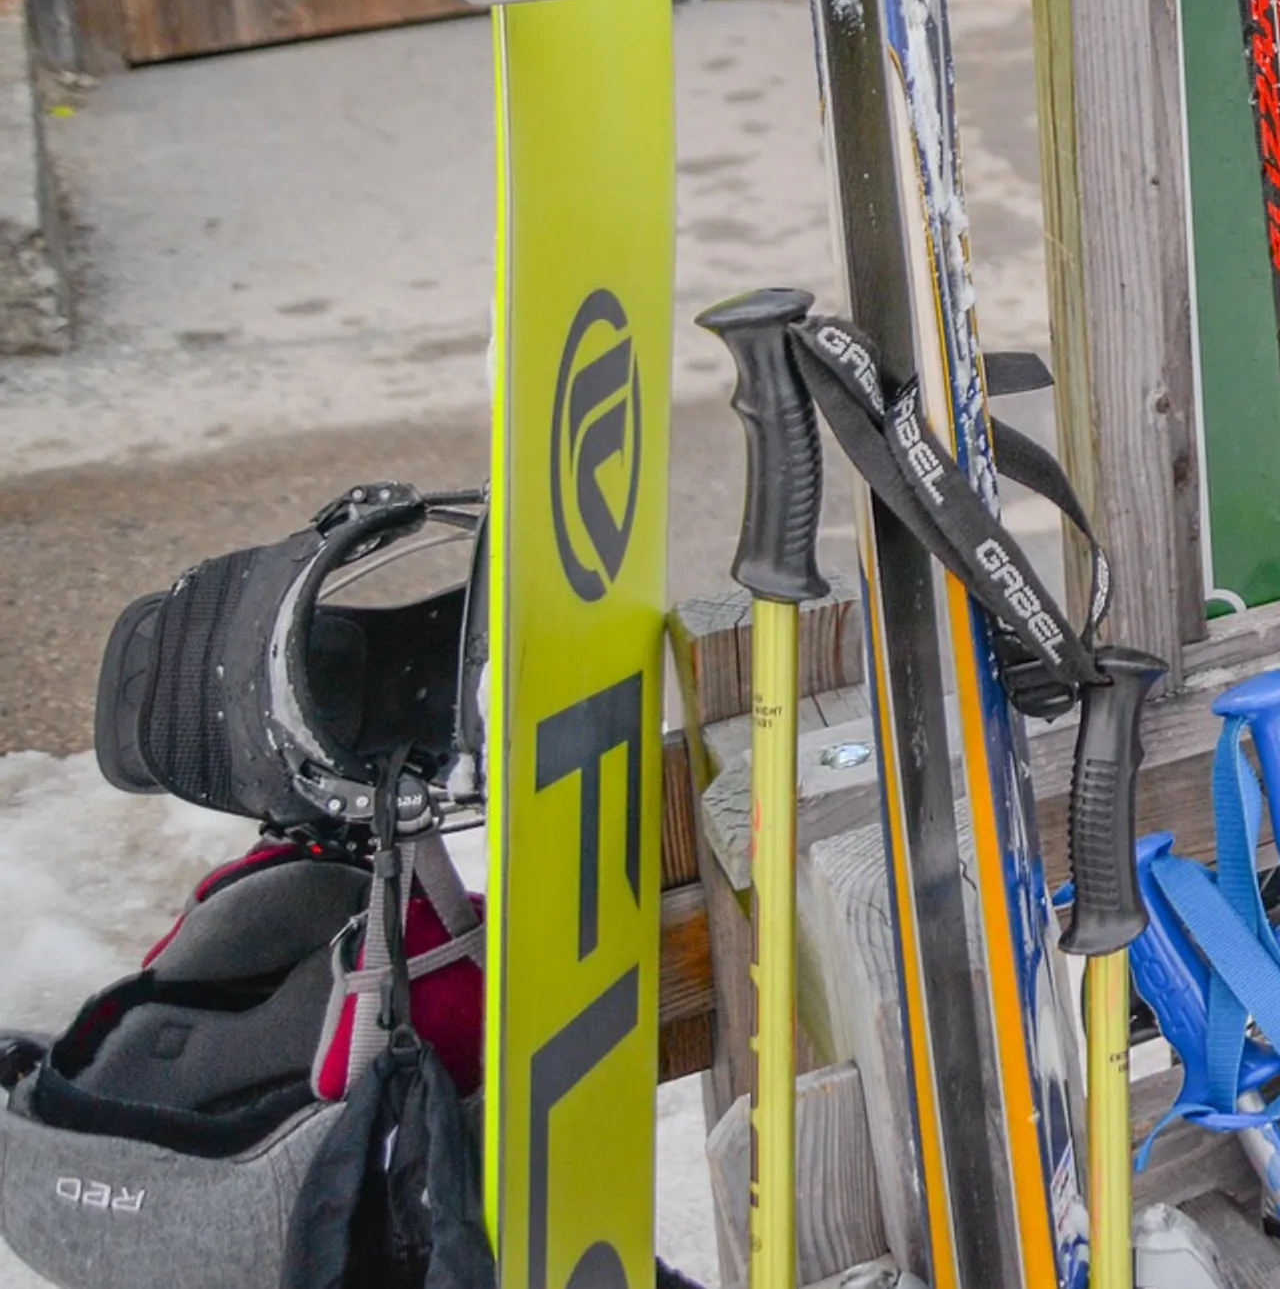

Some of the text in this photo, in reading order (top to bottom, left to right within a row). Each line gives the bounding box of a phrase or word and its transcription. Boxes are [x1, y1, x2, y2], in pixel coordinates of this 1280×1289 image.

[974, 537, 1064, 667] GABEL
[529, 669, 643, 1289] FL
[56, 1175, 147, 1214] RED
